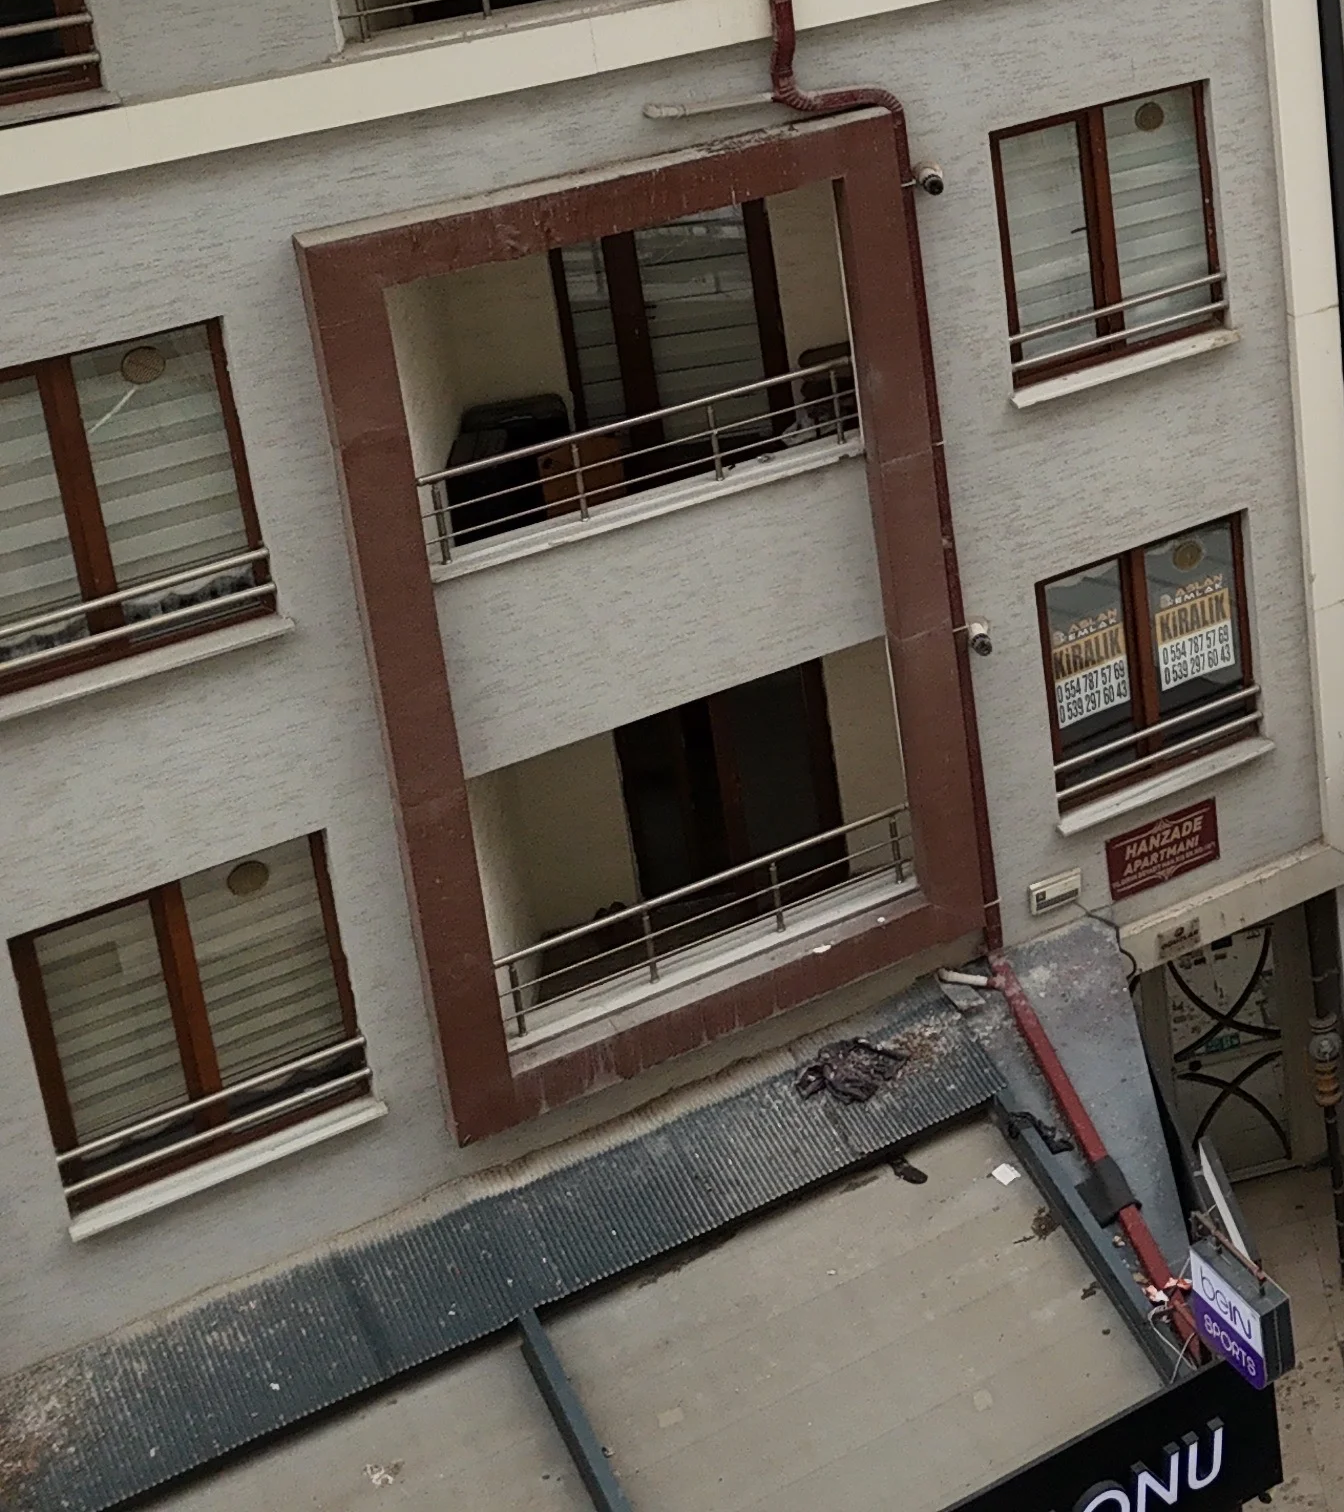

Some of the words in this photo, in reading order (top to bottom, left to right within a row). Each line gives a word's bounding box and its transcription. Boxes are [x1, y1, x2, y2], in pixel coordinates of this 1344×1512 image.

[1068, 616, 1118, 642] EMLAK
[1159, 591, 1227, 644] KİRALIK
[1053, 627, 1123, 681] KİRALIK
[1162, 647, 1169, 666] 0
[1170, 640, 1187, 663] 554
[1188, 633, 1204, 656] 787
[1205, 629, 1216, 649] 57
[1218, 624, 1229, 645] 69
[1164, 666, 1171, 685] 0
[1171, 659, 1189, 683] 539
[1190, 653, 1206, 675] 297
[1207, 648, 1219, 669] 60
[1220, 643, 1231, 663] 43
[1056, 684, 1064, 704] 0
[1064, 676, 1081, 701] 554
[1082, 669, 1100, 693] 787
[1100, 664, 1112, 686] 57
[1113, 659, 1125, 681] 69
[1059, 704, 1066, 724] 0
[1066, 696, 1084, 720] 539
[1085, 689, 1101, 713] 297
[1103, 684, 1115, 706] 60
[1116, 679, 1128, 699] 43
[1122, 834, 1200, 877] APARTMANI
[1124, 815, 1205, 861] HANZADE
[1203, 1313, 1258, 1379] SPORTS
